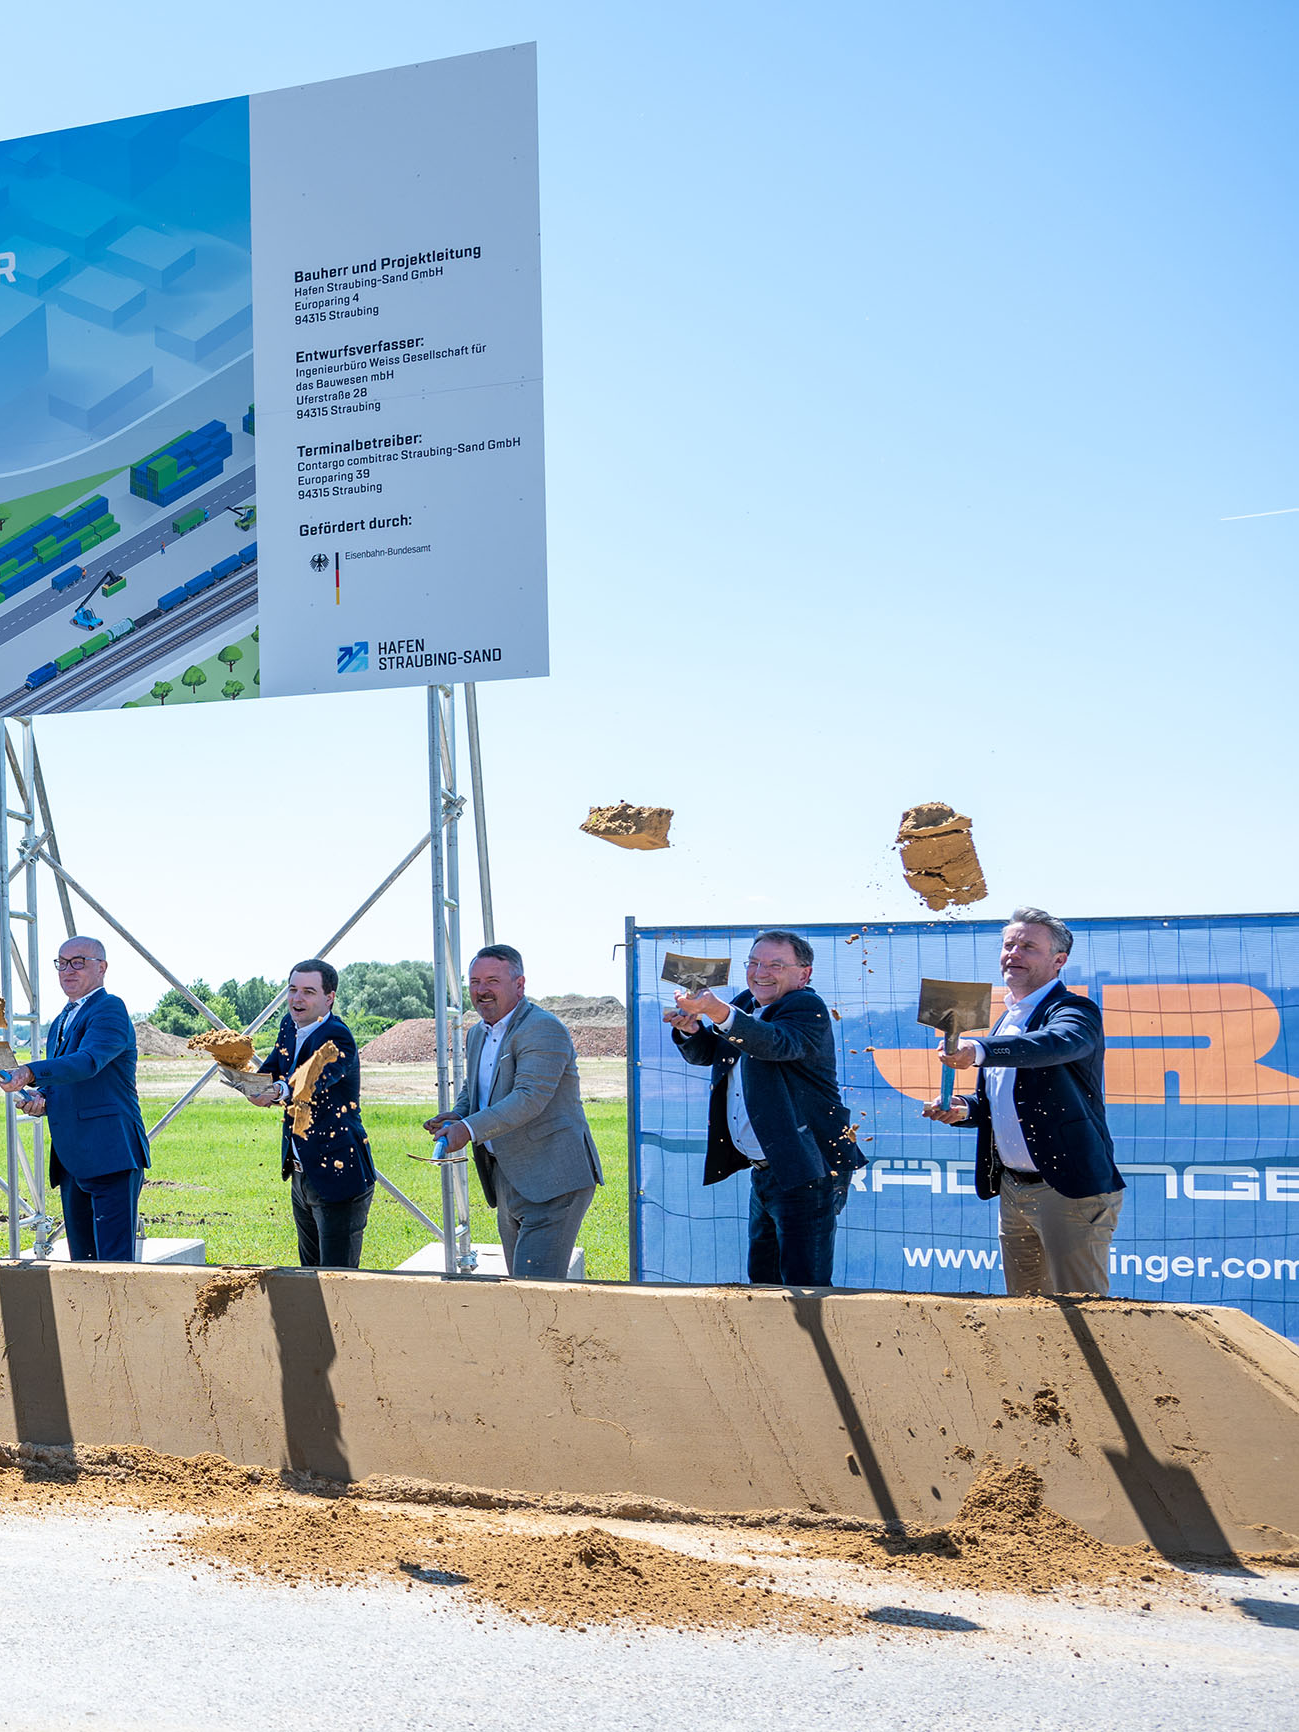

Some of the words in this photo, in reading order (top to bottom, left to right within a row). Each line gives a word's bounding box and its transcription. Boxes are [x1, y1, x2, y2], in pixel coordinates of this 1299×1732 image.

[295, 266, 348, 283] Bauherr
[352, 259, 376, 274] und
[381, 246, 481, 270] Projektleitung
[294, 286, 324, 297] Hafen
[327, 271, 408, 292] Straubing-Sand
[411, 266, 443, 280] GmbH
[295, 296, 350, 311] Europaring
[352, 293, 359, 302] 4
[295, 312, 326, 325] 94315
[329, 306, 379, 320] Straubing
[296, 337, 424, 363] Entwurfsverfasser:
[296, 360, 367, 377] Ingenieurbüro
[369, 356, 400, 367] Weiss
[403, 346, 469, 363] Gesellschaft
[471, 343, 486, 354] für
[296, 382, 314, 391] das
[316, 375, 368, 389] Bauwesen
[371, 369, 394, 382] mbH
[296, 390, 350, 405] Uferstraße
[353, 387, 367, 398] 28
[296, 406, 328, 419] 94315
[331, 401, 381, 415] Straubing
[297, 434, 422, 457] Terminalbetreiber:
[297, 459, 345, 472] Contargo
[347, 453, 398, 466] combitrac
[401, 441, 485, 460] Straubing-Sand
[488, 437, 521, 450] GmbH
[298, 472, 353, 486] Europaring
[356, 469, 370, 479] 39
[298, 487, 330, 500] 94315
[332, 483, 382, 496] Straubing
[299, 520, 365, 536] Gefördert
[369, 514, 412, 529] durch:
[345, 544, 431, 560] Eisenbahn-Bundesamt
[378, 638, 424, 655] HAFEN
[379, 648, 501, 670] STRAUBING-SAND
